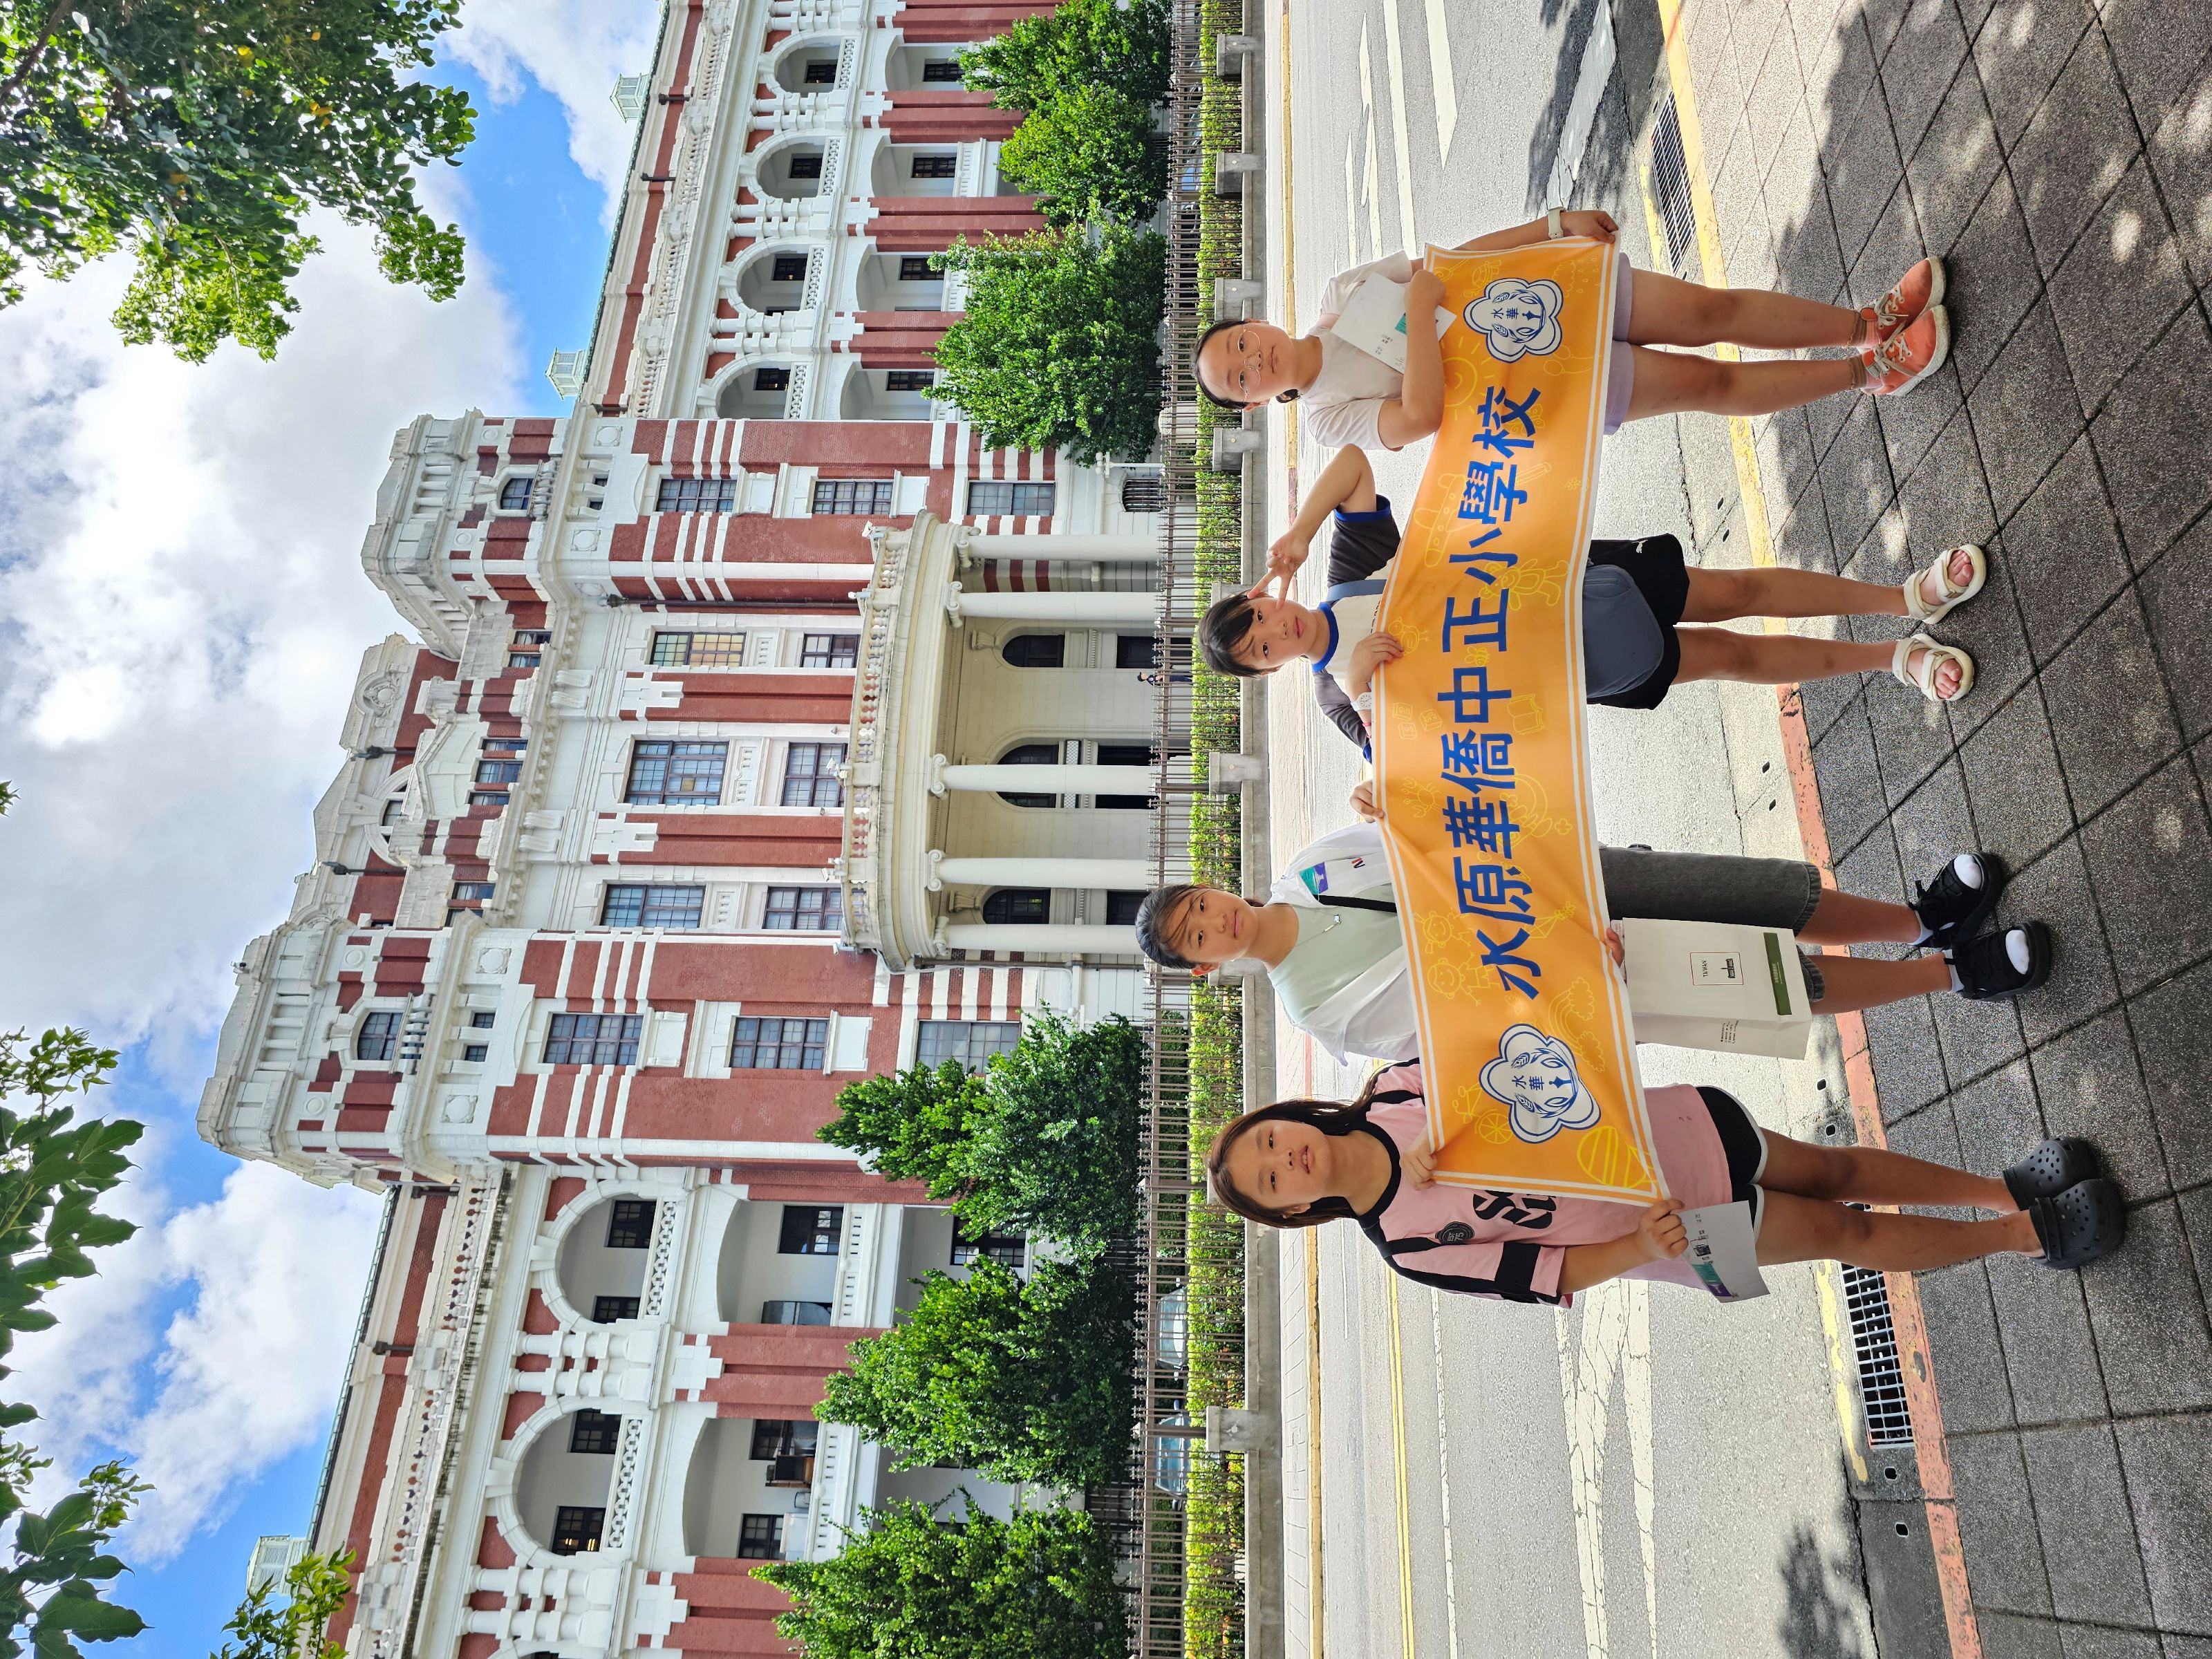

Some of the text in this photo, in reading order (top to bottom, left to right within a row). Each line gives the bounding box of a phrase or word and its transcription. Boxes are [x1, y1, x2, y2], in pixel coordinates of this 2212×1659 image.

[1490, 308, 1519, 320] 水華
[1436, 386, 1541, 1000] 水原華僑中正小學校
[1511, 1074, 1545, 1091] 水華
[1454, 1232, 1464, 1241] 75
